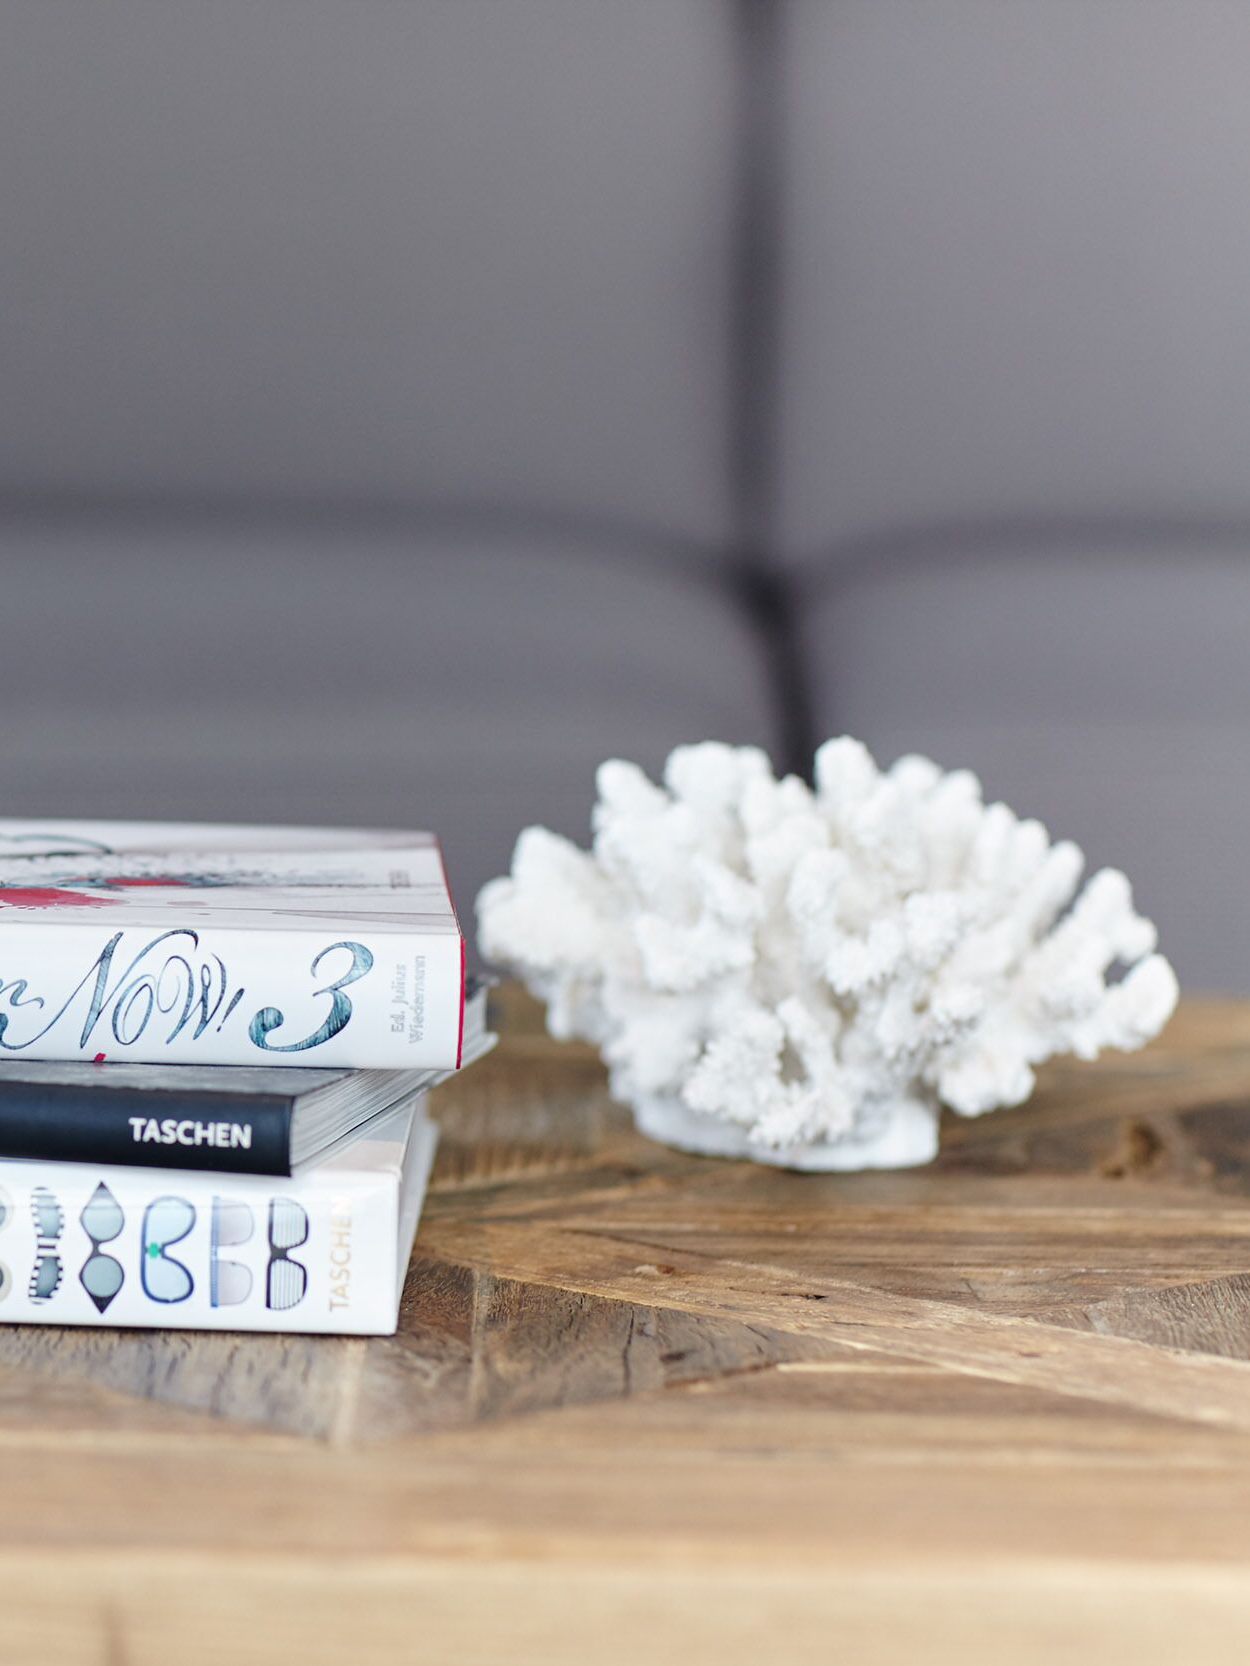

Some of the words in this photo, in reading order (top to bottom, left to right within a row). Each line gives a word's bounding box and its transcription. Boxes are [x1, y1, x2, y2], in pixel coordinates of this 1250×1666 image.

[248, 940, 374, 1053] 3
[391, 963, 409, 1006] Julius
[408, 955, 426, 1044] Wiedemann
[390, 1010, 406, 1033] Ed.
[128, 1116, 252, 1149] TASCHEN
